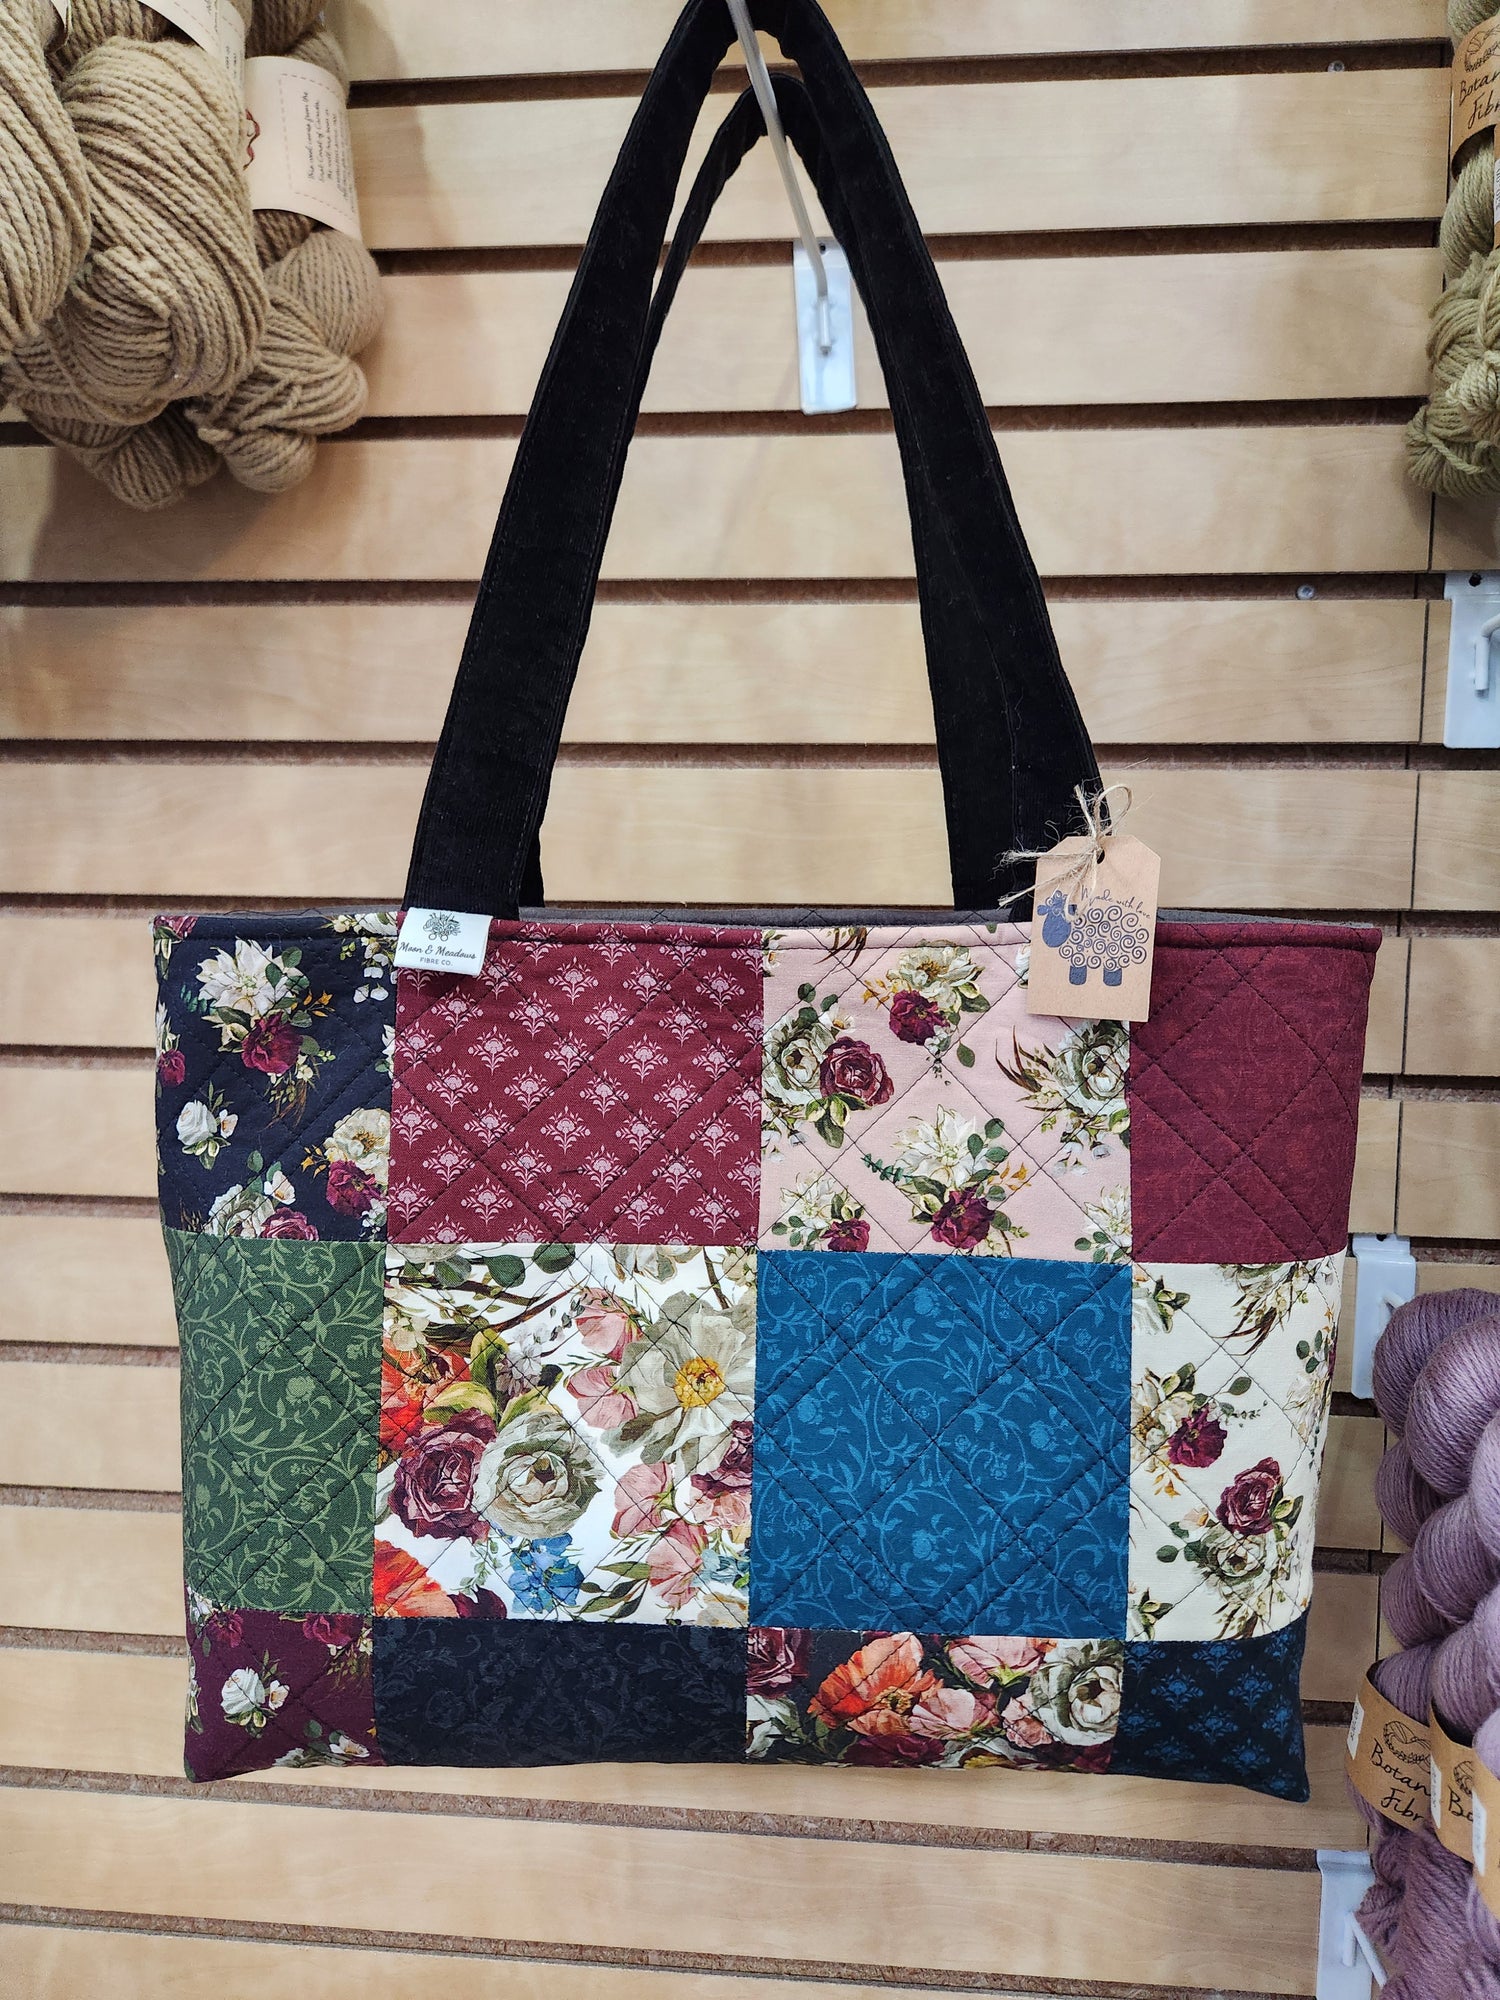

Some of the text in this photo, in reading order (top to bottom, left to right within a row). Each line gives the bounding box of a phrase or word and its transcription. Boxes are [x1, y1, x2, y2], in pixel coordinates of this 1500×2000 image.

[1116, 896, 1135, 909] with
[1136, 901, 1150, 918] love
[398, 942, 476, 959] Moon & Meadows
[420, 957, 439, 965] FIBRE
